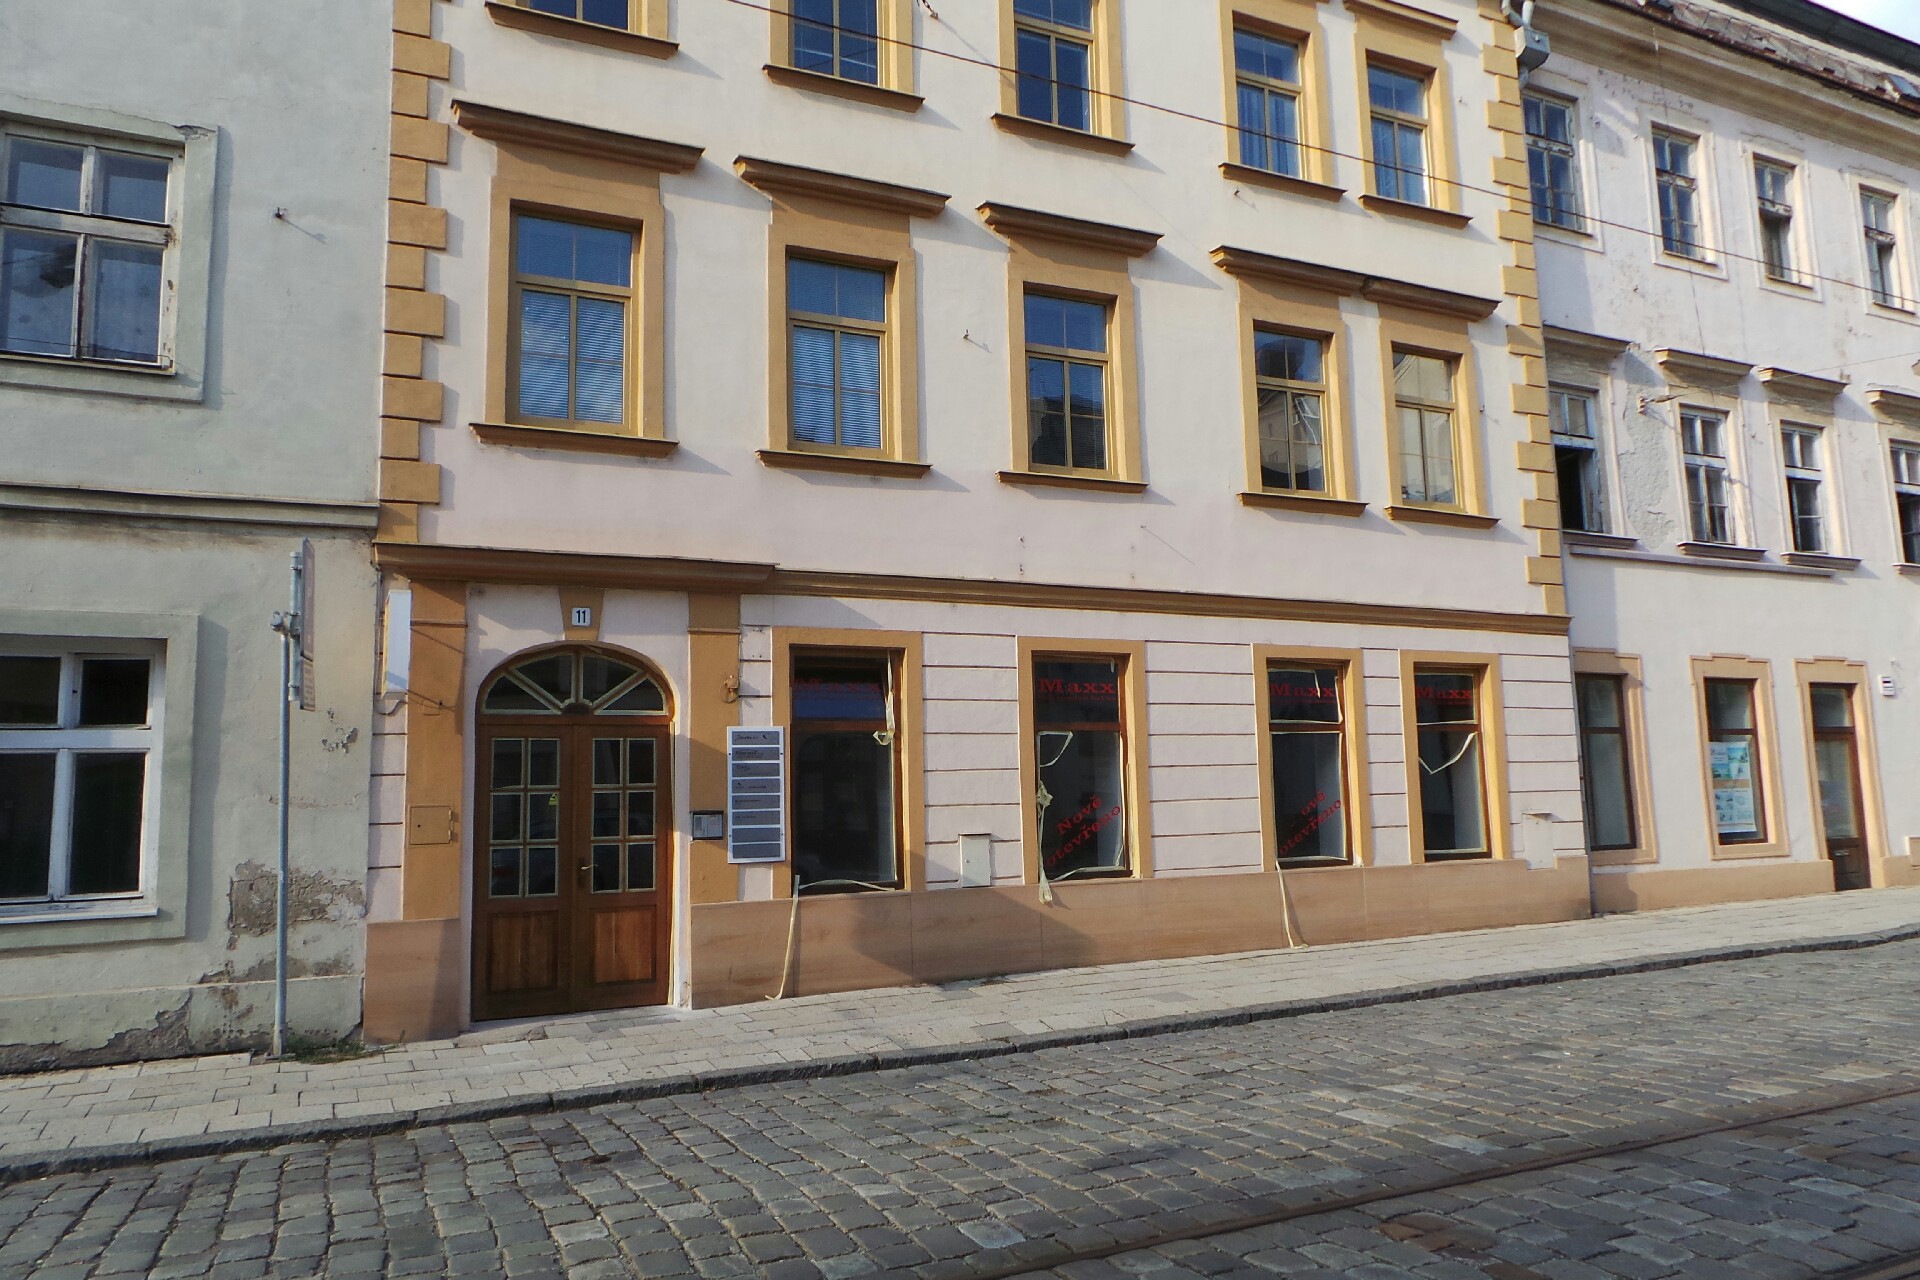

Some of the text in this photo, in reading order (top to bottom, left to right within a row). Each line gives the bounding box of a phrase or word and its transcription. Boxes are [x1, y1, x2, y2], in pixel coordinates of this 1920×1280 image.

[576, 609, 586, 624] 11
[1038, 678, 1117, 694] Maxx
[1270, 683, 1335, 697] Maxx
[1415, 686, 1472, 700] Maxx
[1045, 805, 1121, 867] otevřeno
